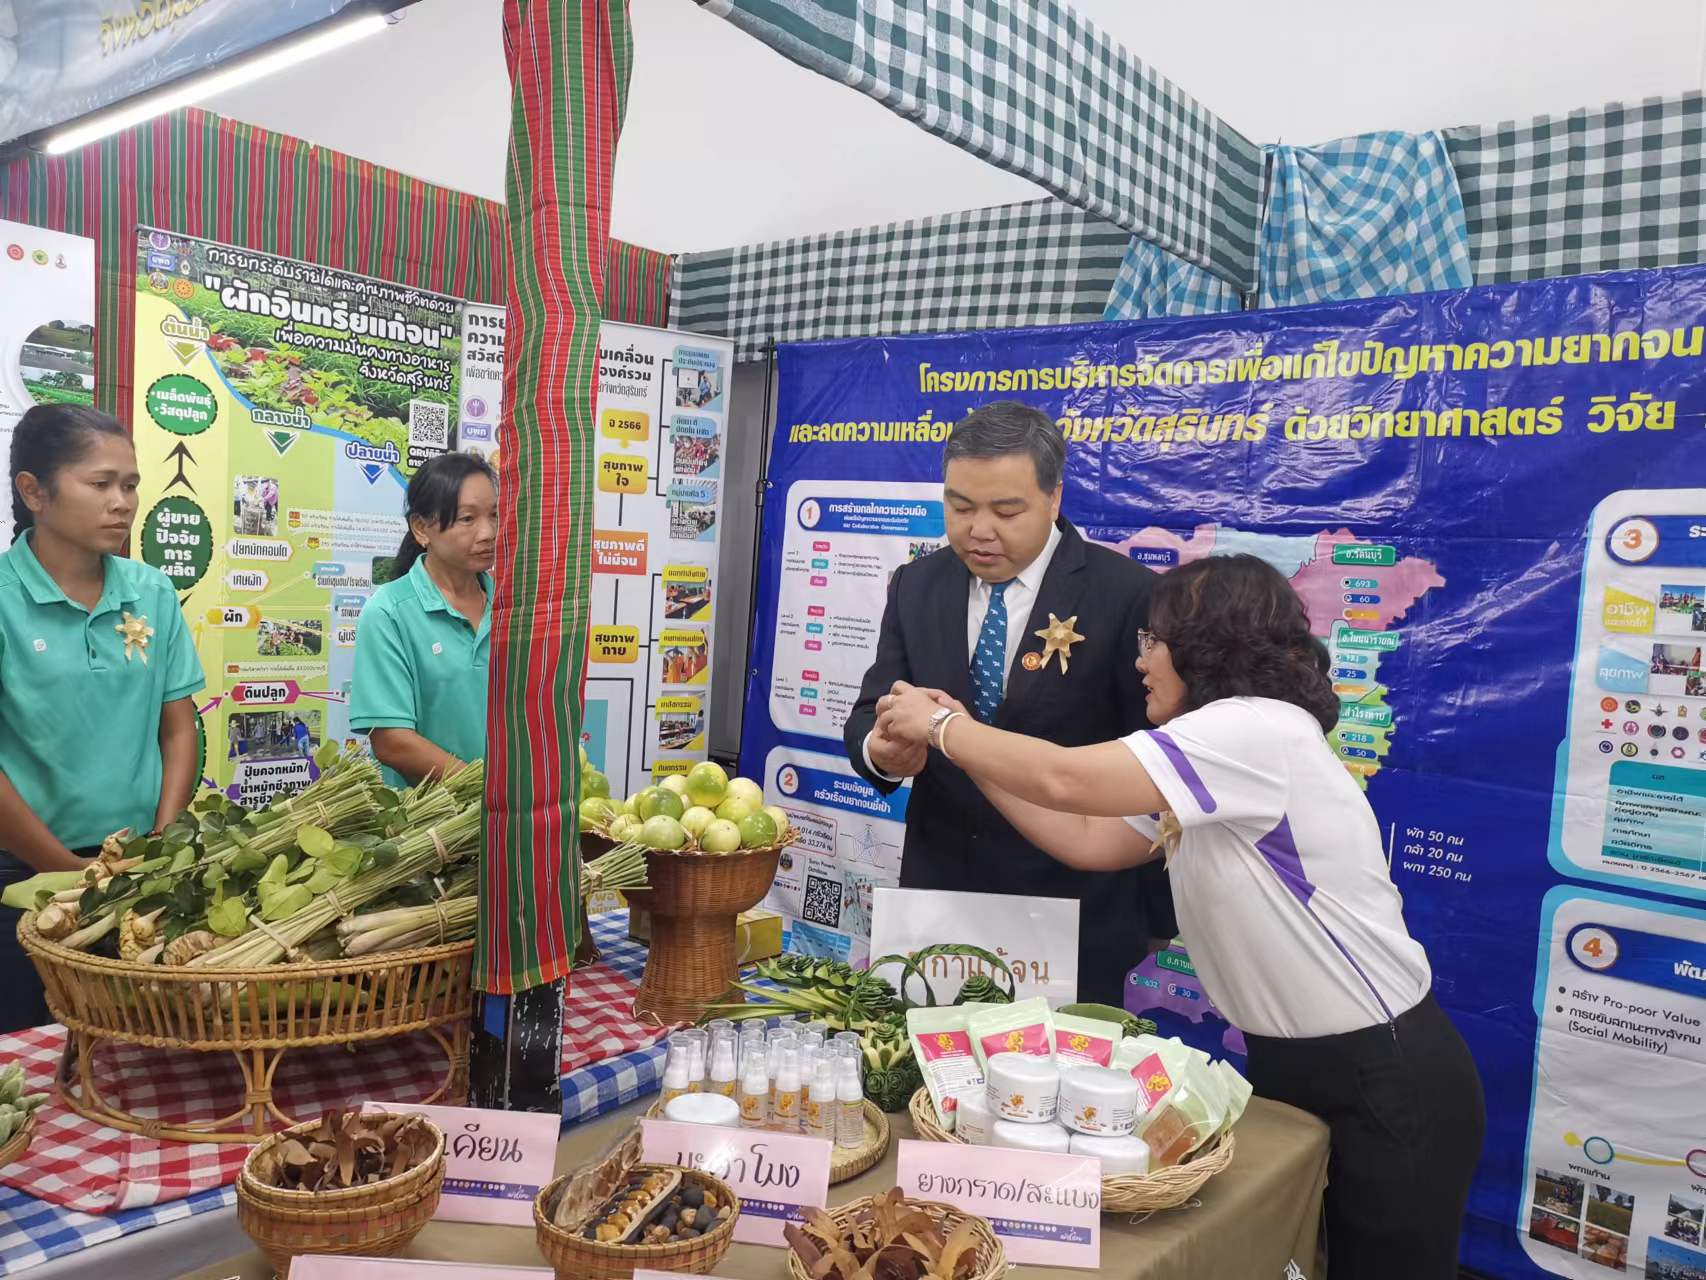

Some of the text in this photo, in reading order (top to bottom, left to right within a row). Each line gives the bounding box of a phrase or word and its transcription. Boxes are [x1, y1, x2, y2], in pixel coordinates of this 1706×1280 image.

[208, 248, 455, 314] การยกระดับรายได้และคุณภาพชีวิตด้วย
[163, 317, 210, 340] ต้นน้ำ
[275, 321, 451, 372] เพื่อความมั่นคงทางอาหาร
[360, 358, 452, 393] จังหวัดสุรินทร์
[252, 409, 312, 428] กลางน้ำ
[609, 418, 641, 430] ปี 2566
[788, 409, 953, 443] และลดความเหลื่อ
[1284, 396, 1564, 442] ด้วยวิทยาศาสตร์
[1587, 392, 1676, 434] วิจัย
[347, 442, 400, 462] ปลายน้ำ
[603, 461, 643, 473] สุขภาพ
[616, 472, 629, 487] ใจ
[806, 506, 812, 520] 1
[829, 502, 927, 517] การสร้างกลไกความร่วมมือ
[156, 528, 200, 546] ปัจจัย
[1622, 528, 1642, 549] 3
[594, 538, 645, 554] สุขภาพดี
[164, 549, 192, 561] การ
[598, 552, 638, 567] ไม่มีจน
[1355, 580, 1371, 588] 693
[1359, 595, 1370, 603] 60
[224, 609, 244, 623] ผัก
[595, 633, 634, 647] สุขภาพ
[602, 647, 627, 656] กาย
[244, 685, 286, 702] ดินปลูก
[783, 772, 794, 787] 2
[834, 781, 874, 796] ระบบข้อมูล
[1428, 831, 1443, 842] 50
[1446, 835, 1464, 846] คน
[1428, 847, 1443, 859] 20
[1446, 852, 1463, 863] คน
[1429, 865, 1452, 878] 250
[1454, 871, 1472, 883] คน
[1582, 937, 1603, 957] 4
[1182, 988, 1191, 998] 30
[1572, 989, 1701, 1028] สร้าง Pro-poor Value
[1568, 1019, 1668, 1054] (Social Mobility)
[918, 1172, 1100, 1210] ยางกราด/สะแบง
